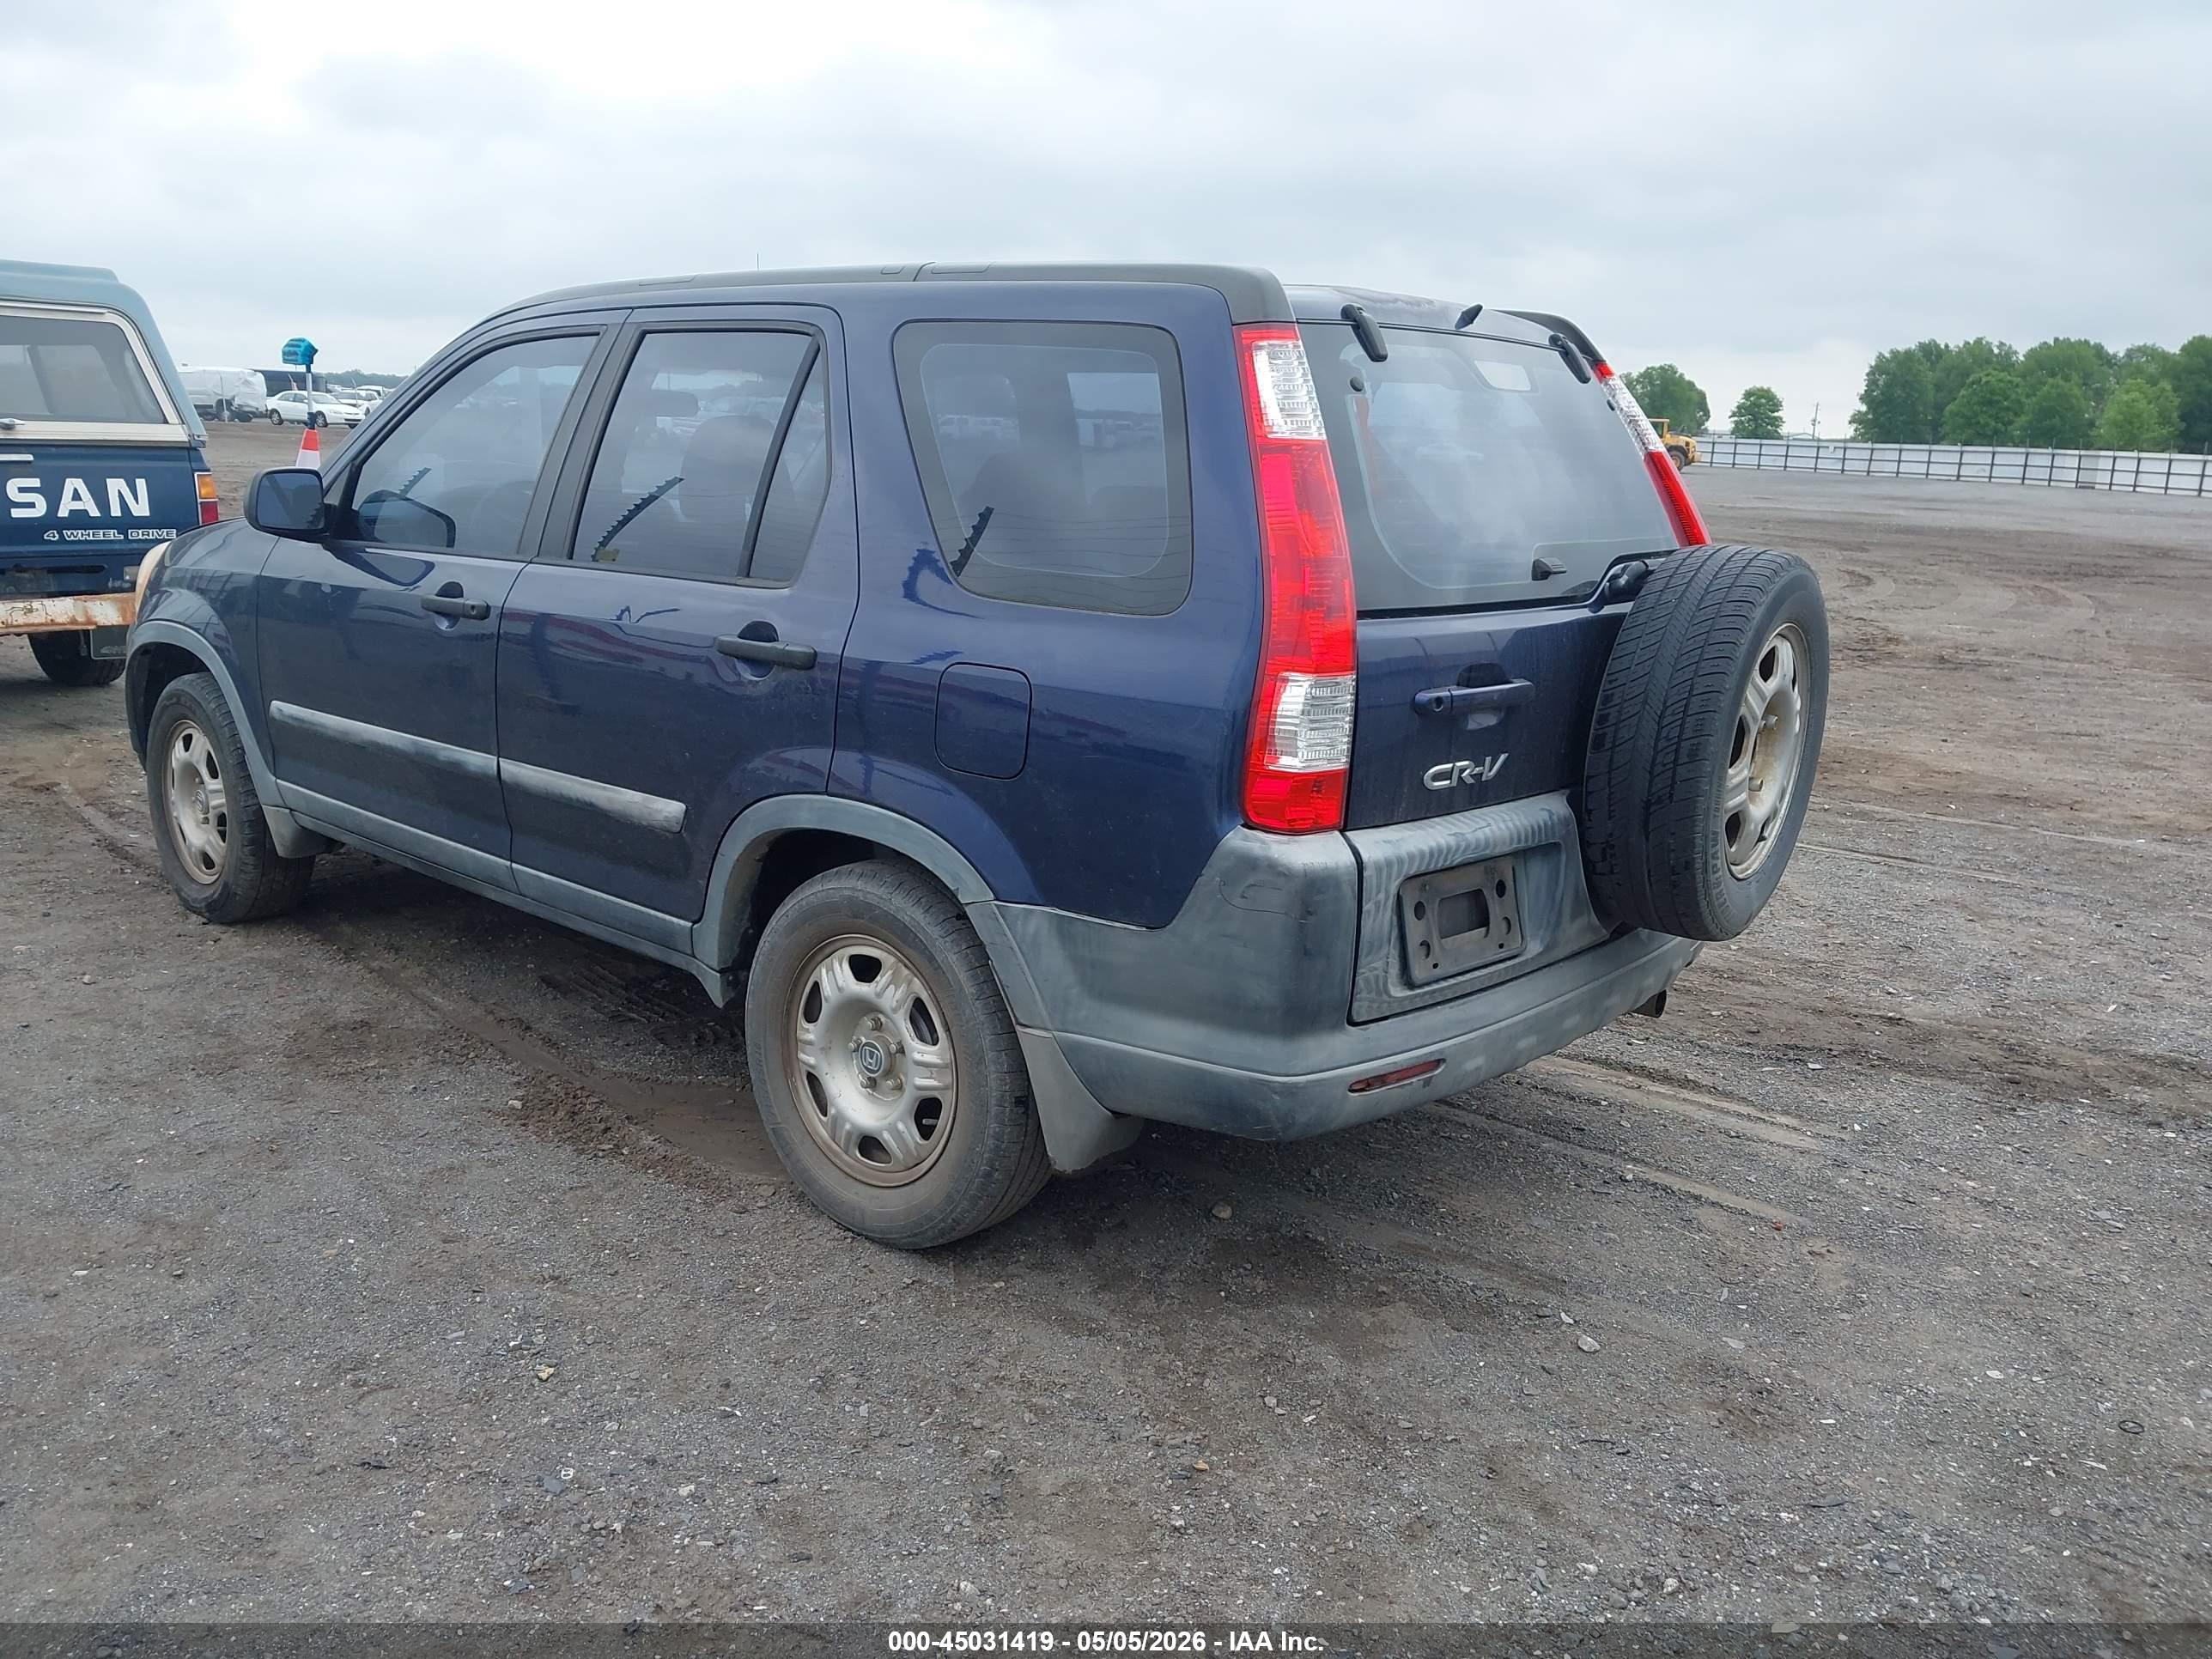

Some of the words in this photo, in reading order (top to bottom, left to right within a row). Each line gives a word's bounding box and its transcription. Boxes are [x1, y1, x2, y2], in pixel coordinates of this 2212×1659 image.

[44, 530, 59, 541] 4
[63, 530, 125, 541] WHEEL
[128, 528, 177, 540] DRIVE
[1423, 752, 1510, 790] CR-V
